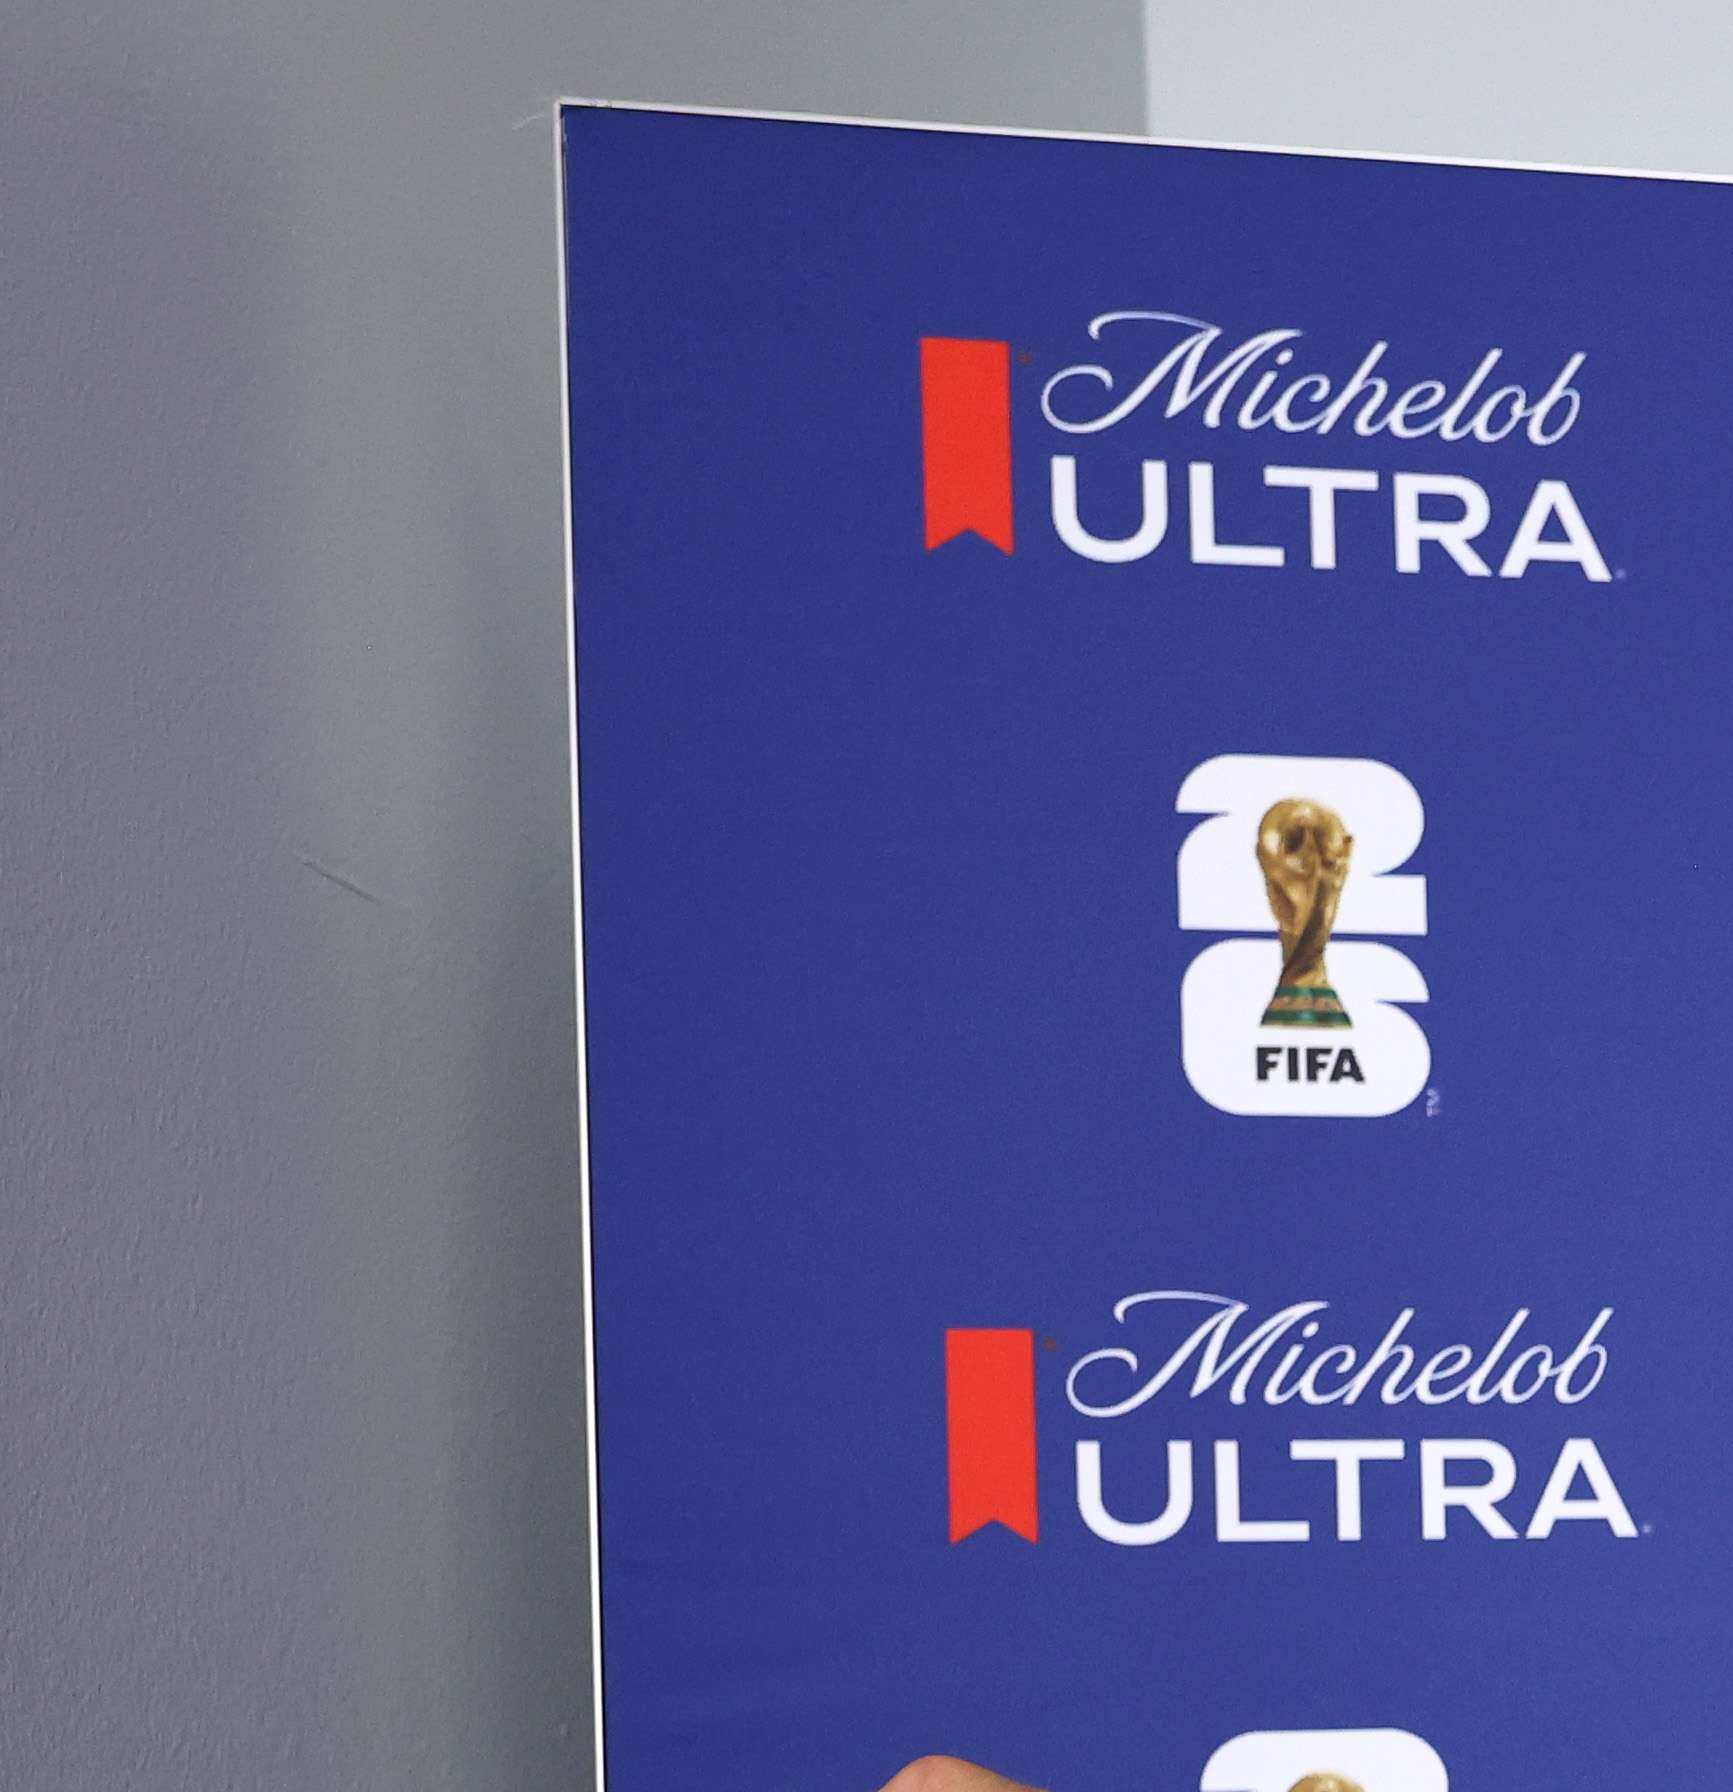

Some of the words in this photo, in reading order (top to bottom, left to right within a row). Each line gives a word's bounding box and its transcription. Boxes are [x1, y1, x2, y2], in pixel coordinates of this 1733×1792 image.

[1041, 311, 1586, 445] Michelob
[1051, 455, 1612, 582] ULTRA
[1257, 1047, 1364, 1082] FIFA
[1067, 1291, 1613, 1417] Michelob
[1076, 1438, 1638, 1545] ULTRA
